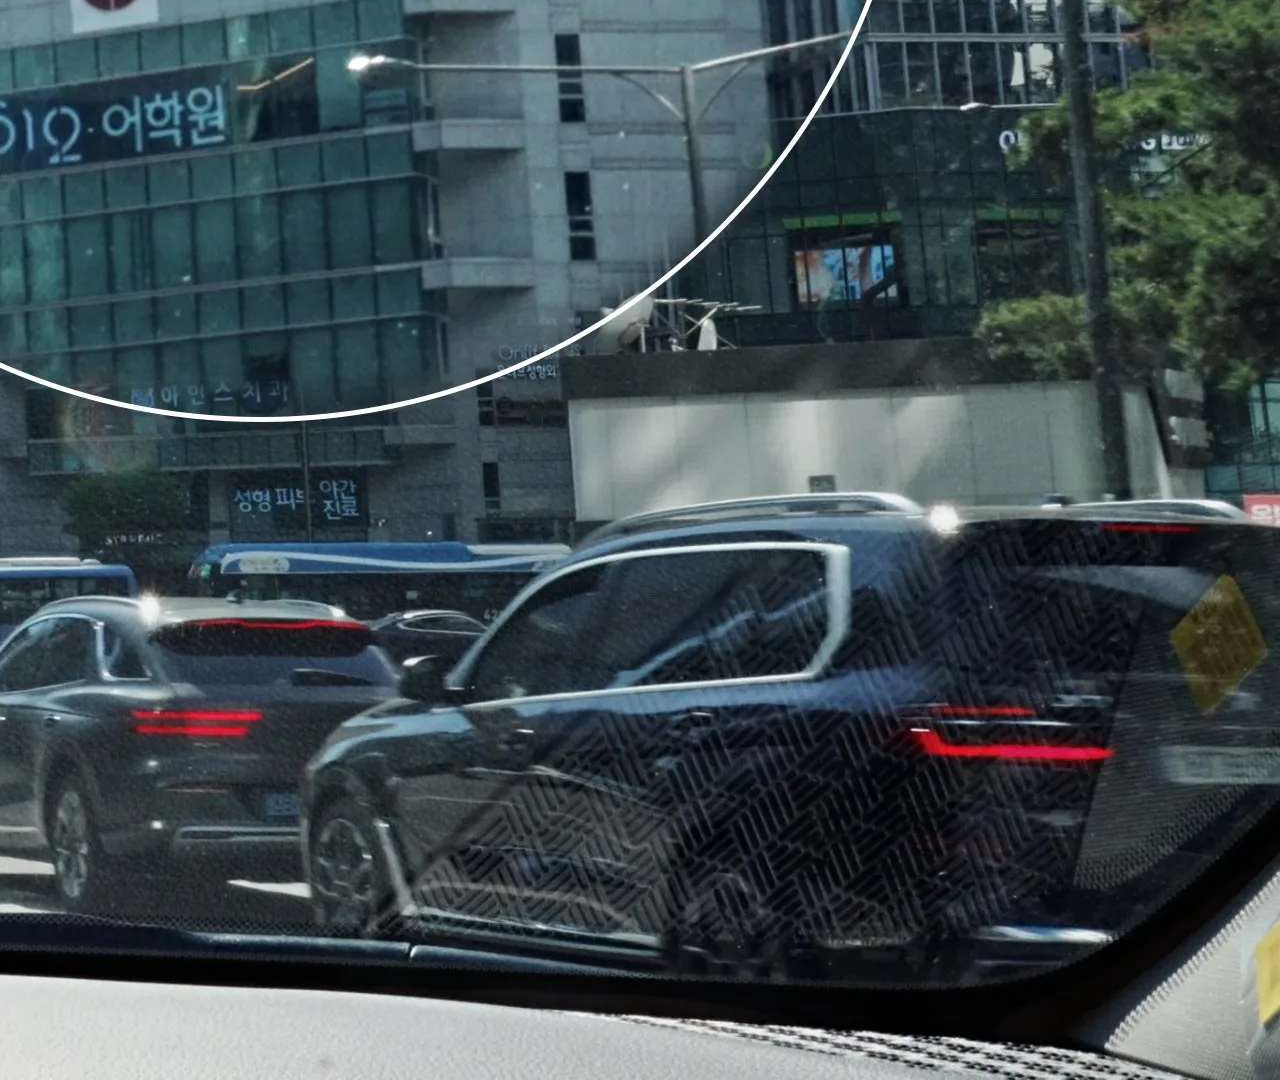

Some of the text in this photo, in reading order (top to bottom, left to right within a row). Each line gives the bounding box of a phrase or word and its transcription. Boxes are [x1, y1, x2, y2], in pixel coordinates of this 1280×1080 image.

[102, 85, 226, 153] 어학원
[234, 488, 271, 513] 성형
[322, 498, 360, 520] 진료
